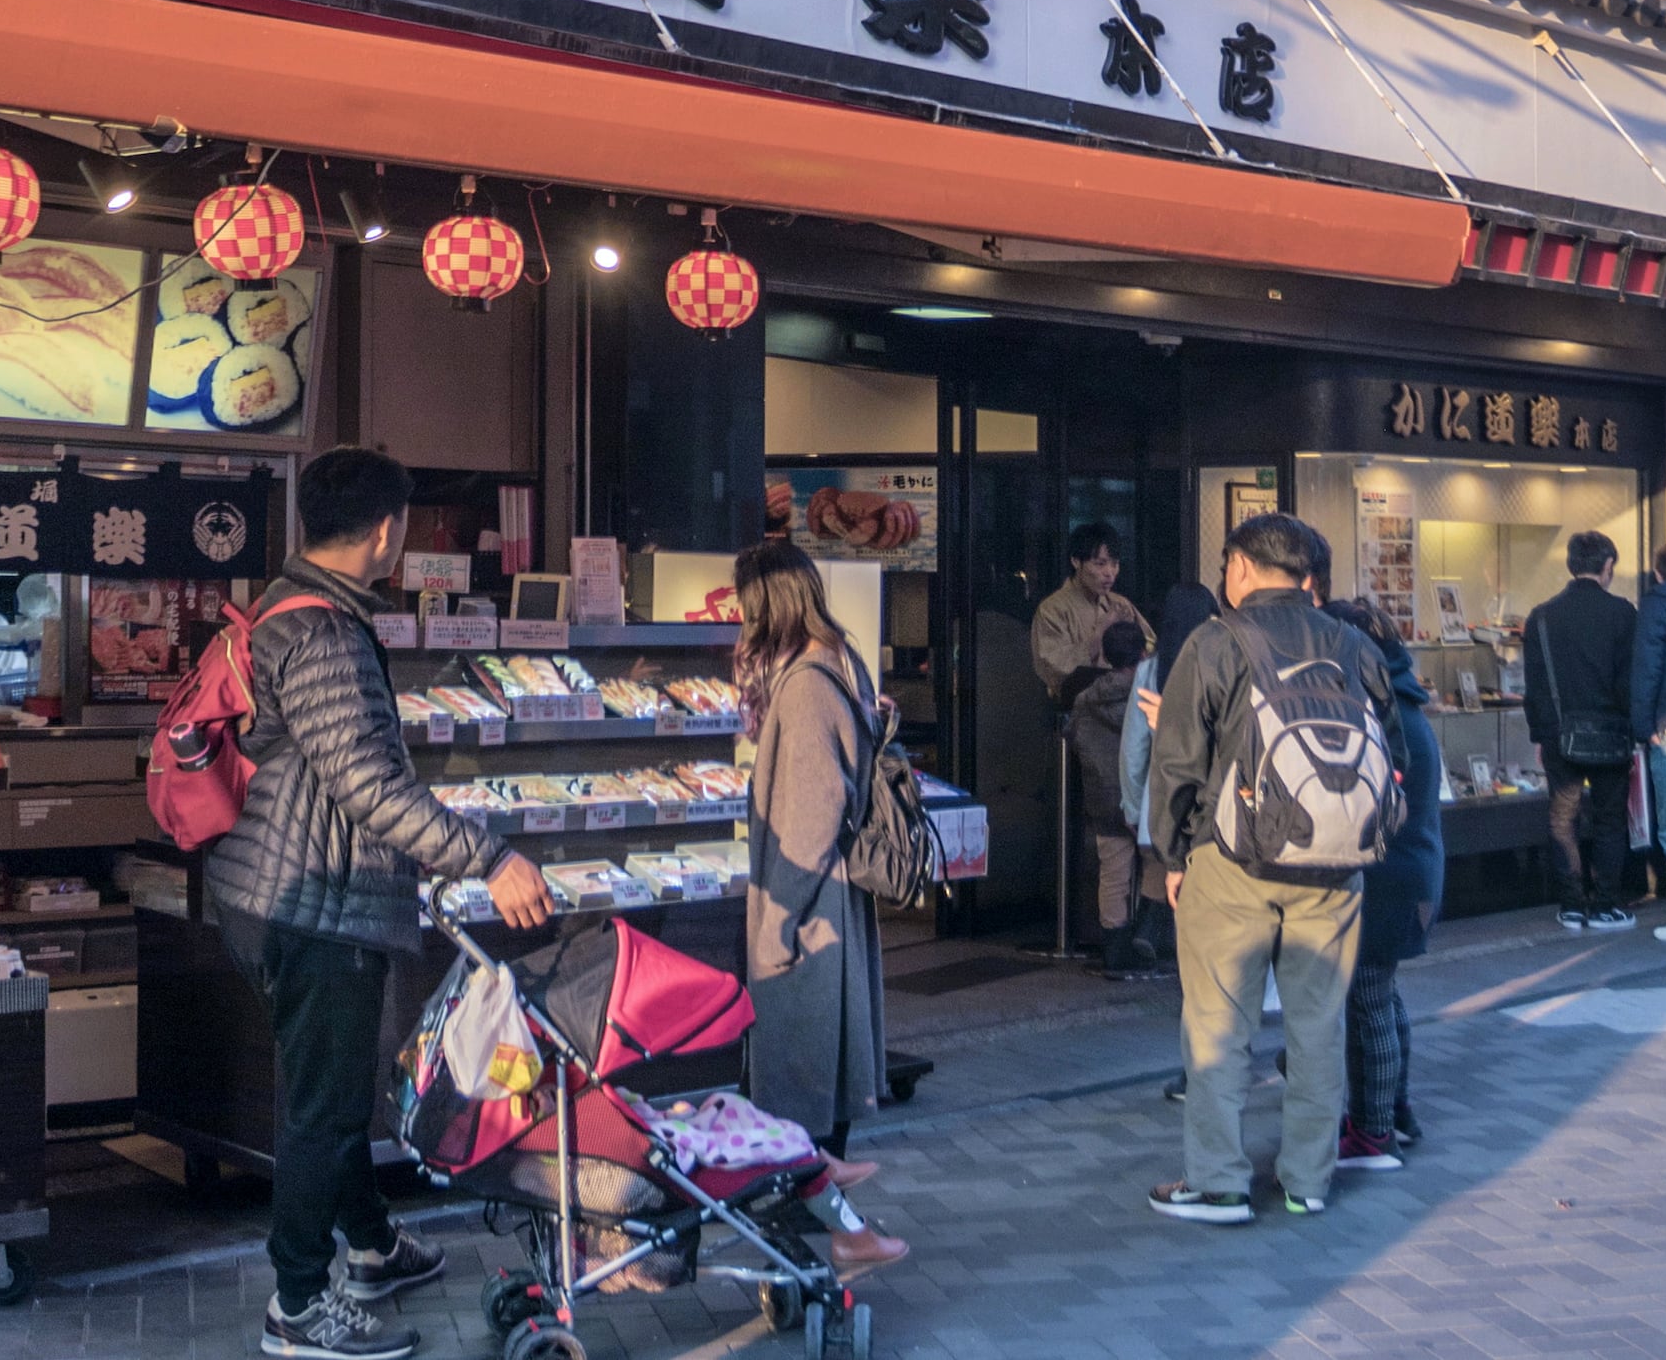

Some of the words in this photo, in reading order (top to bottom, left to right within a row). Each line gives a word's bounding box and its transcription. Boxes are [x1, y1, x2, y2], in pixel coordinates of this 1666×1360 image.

[1573, 416, 1619, 453] 本店
[892, 474, 934, 490] 毛かに
